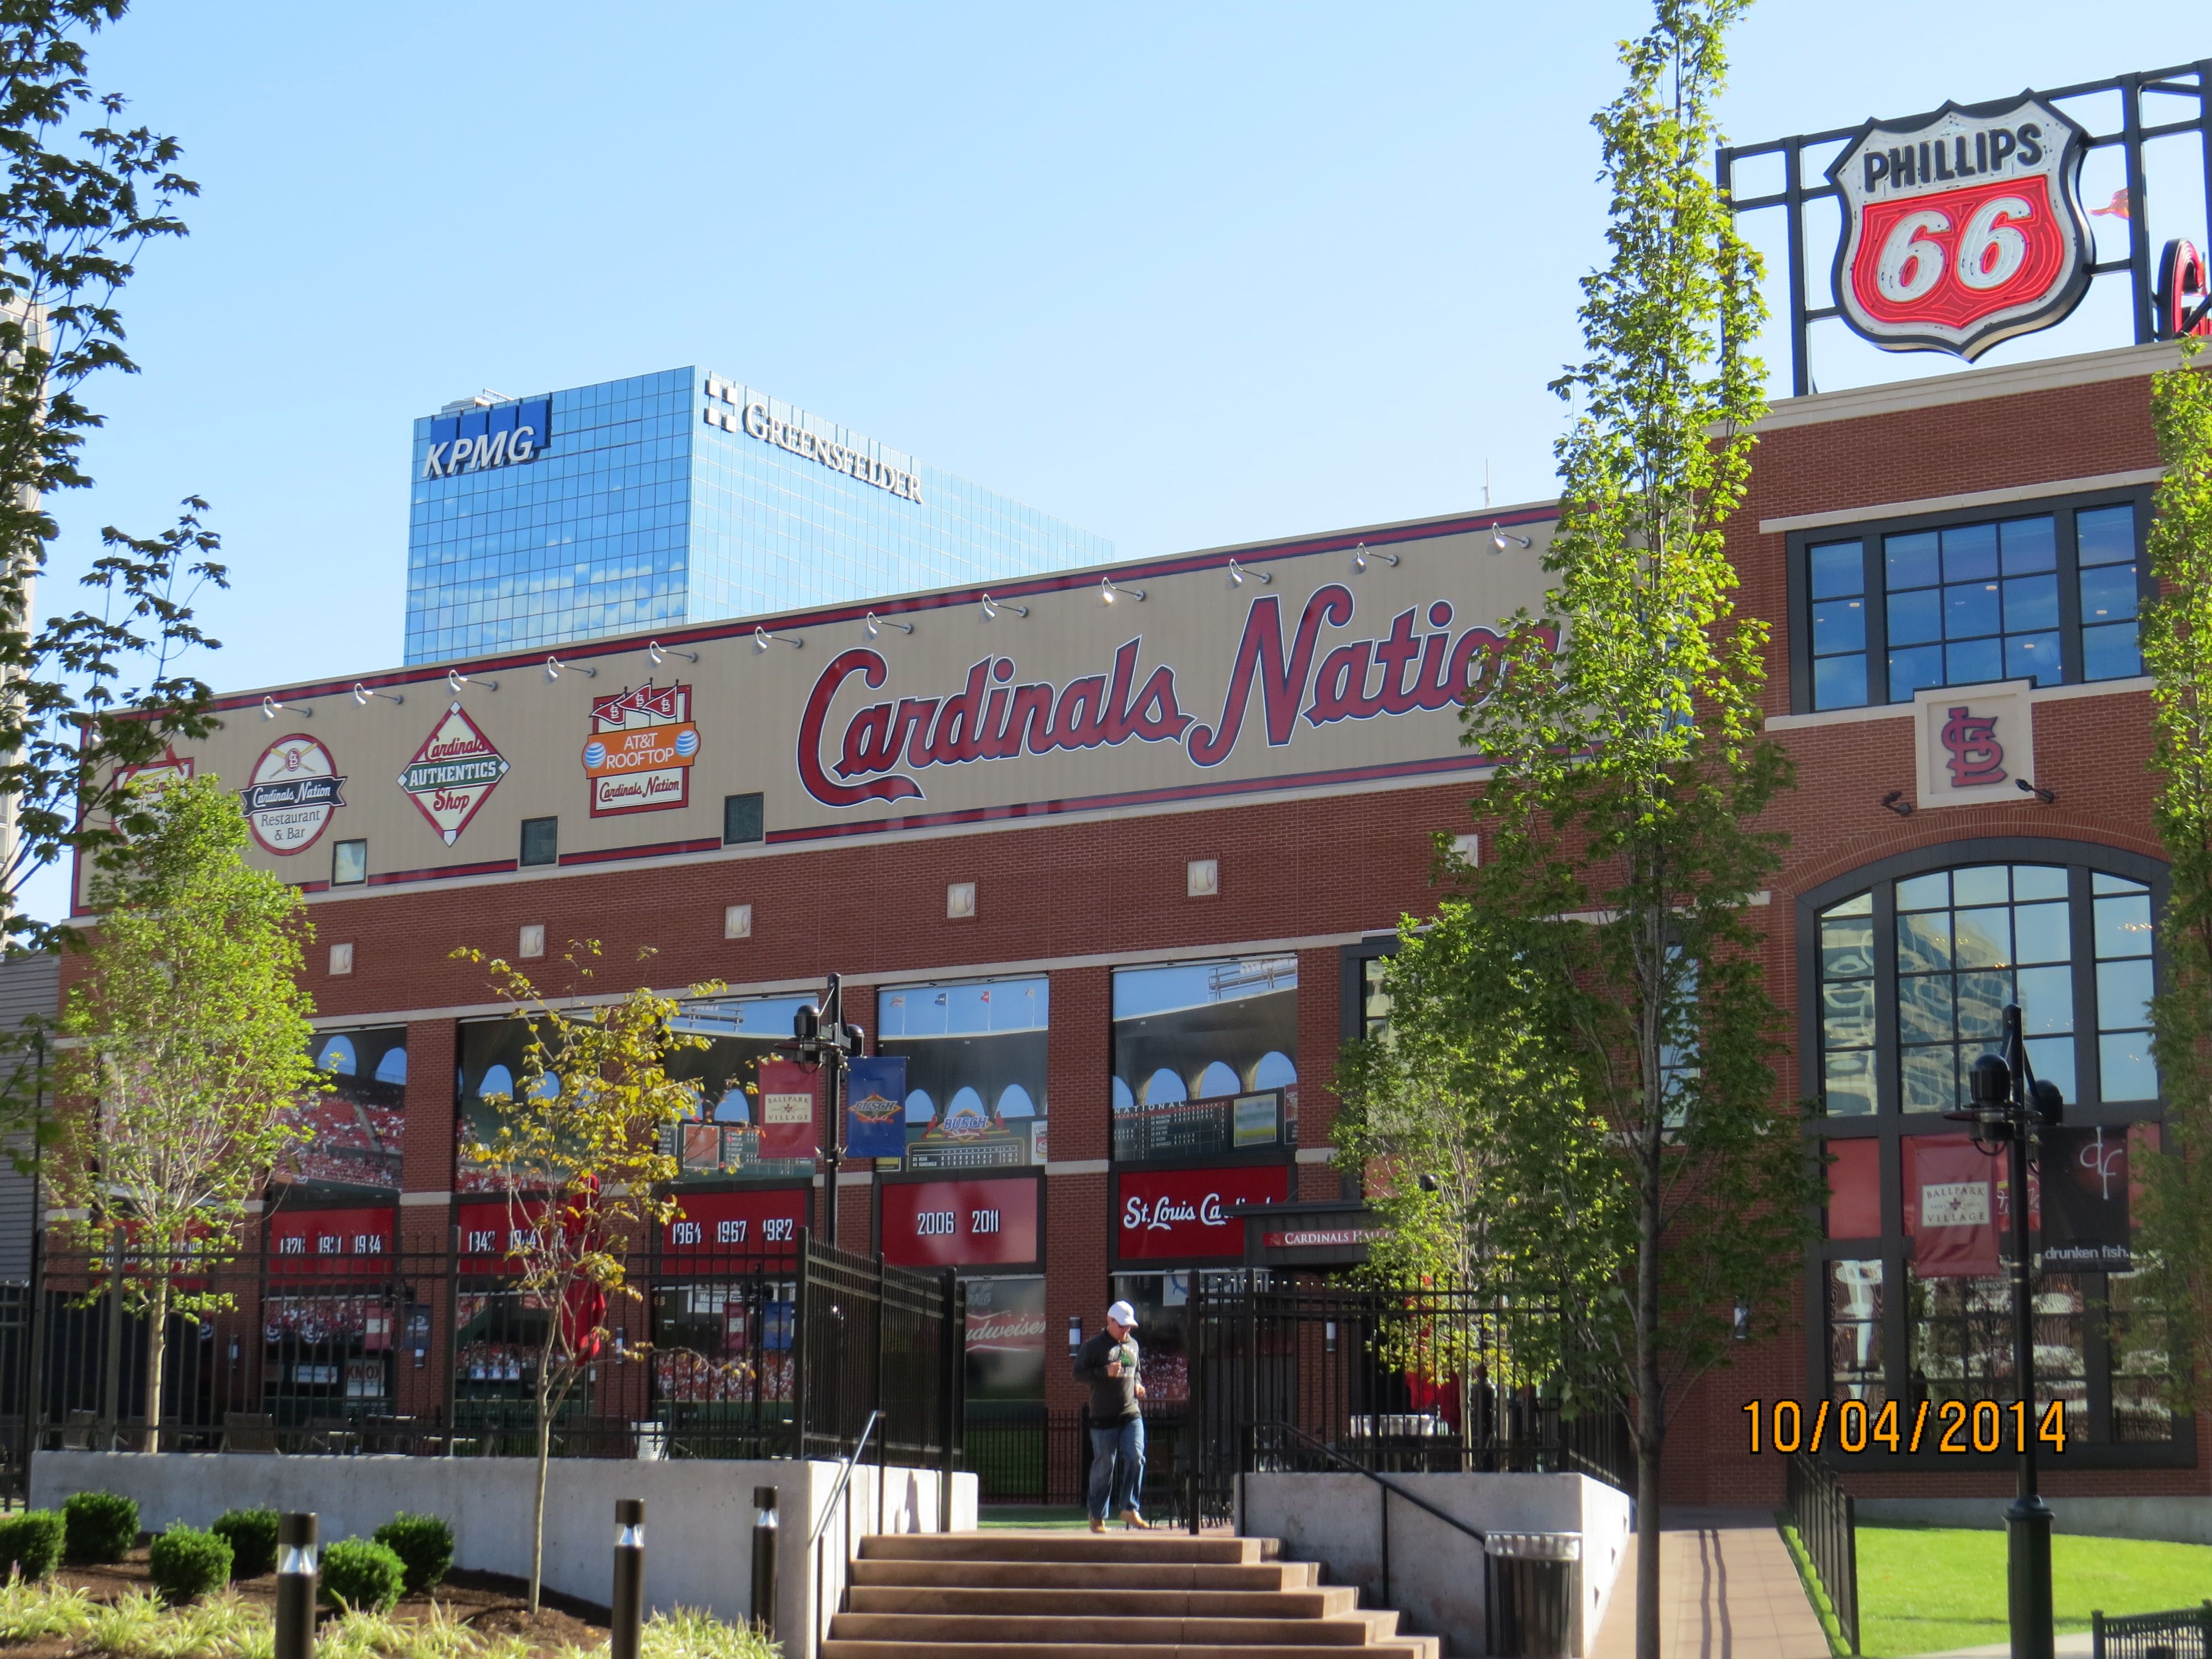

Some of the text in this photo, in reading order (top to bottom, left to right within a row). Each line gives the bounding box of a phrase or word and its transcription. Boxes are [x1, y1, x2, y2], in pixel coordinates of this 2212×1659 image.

[1864, 122, 2044, 193] PHILLIPS
[1876, 195, 2034, 303] 66
[421, 425, 535, 479] KPMG
[743, 401, 925, 504] GREENSFELDER
[797, 634, 1197, 808] Cardinals
[425, 734, 486, 763] Cardinals
[623, 732, 658, 751] AT&T
[606, 747, 675, 770] ROOFTOP
[409, 760, 497, 787] AUTHENTICS
[253, 781, 331, 808] Cardinals Nation
[433, 787, 470, 815] Shop
[599, 775, 680, 802] Cardinals Nation
[261, 809, 321, 827] Restaurant
[274, 828, 305, 841] & Bar
[768, 1095, 809, 1104] BALLPARK
[854, 1100, 898, 1111] BUSCH
[1114, 1101, 1185, 1114] NATIONAL
[943, 1115, 989, 1130] BUSCH
[1927, 1186, 1985, 1199] BALLPARK
[917, 1209, 999, 1235] 2006 2011
[1147, 1196, 1196, 1230] Louis
[1927, 1212, 1986, 1223] VILLAGE
[718, 1220, 747, 1243] 1967
[763, 1218, 793, 1241] 1982
[1285, 1232, 1349, 1244] CARDINALS
[2046, 1244, 2129, 1260] drunken fish.
